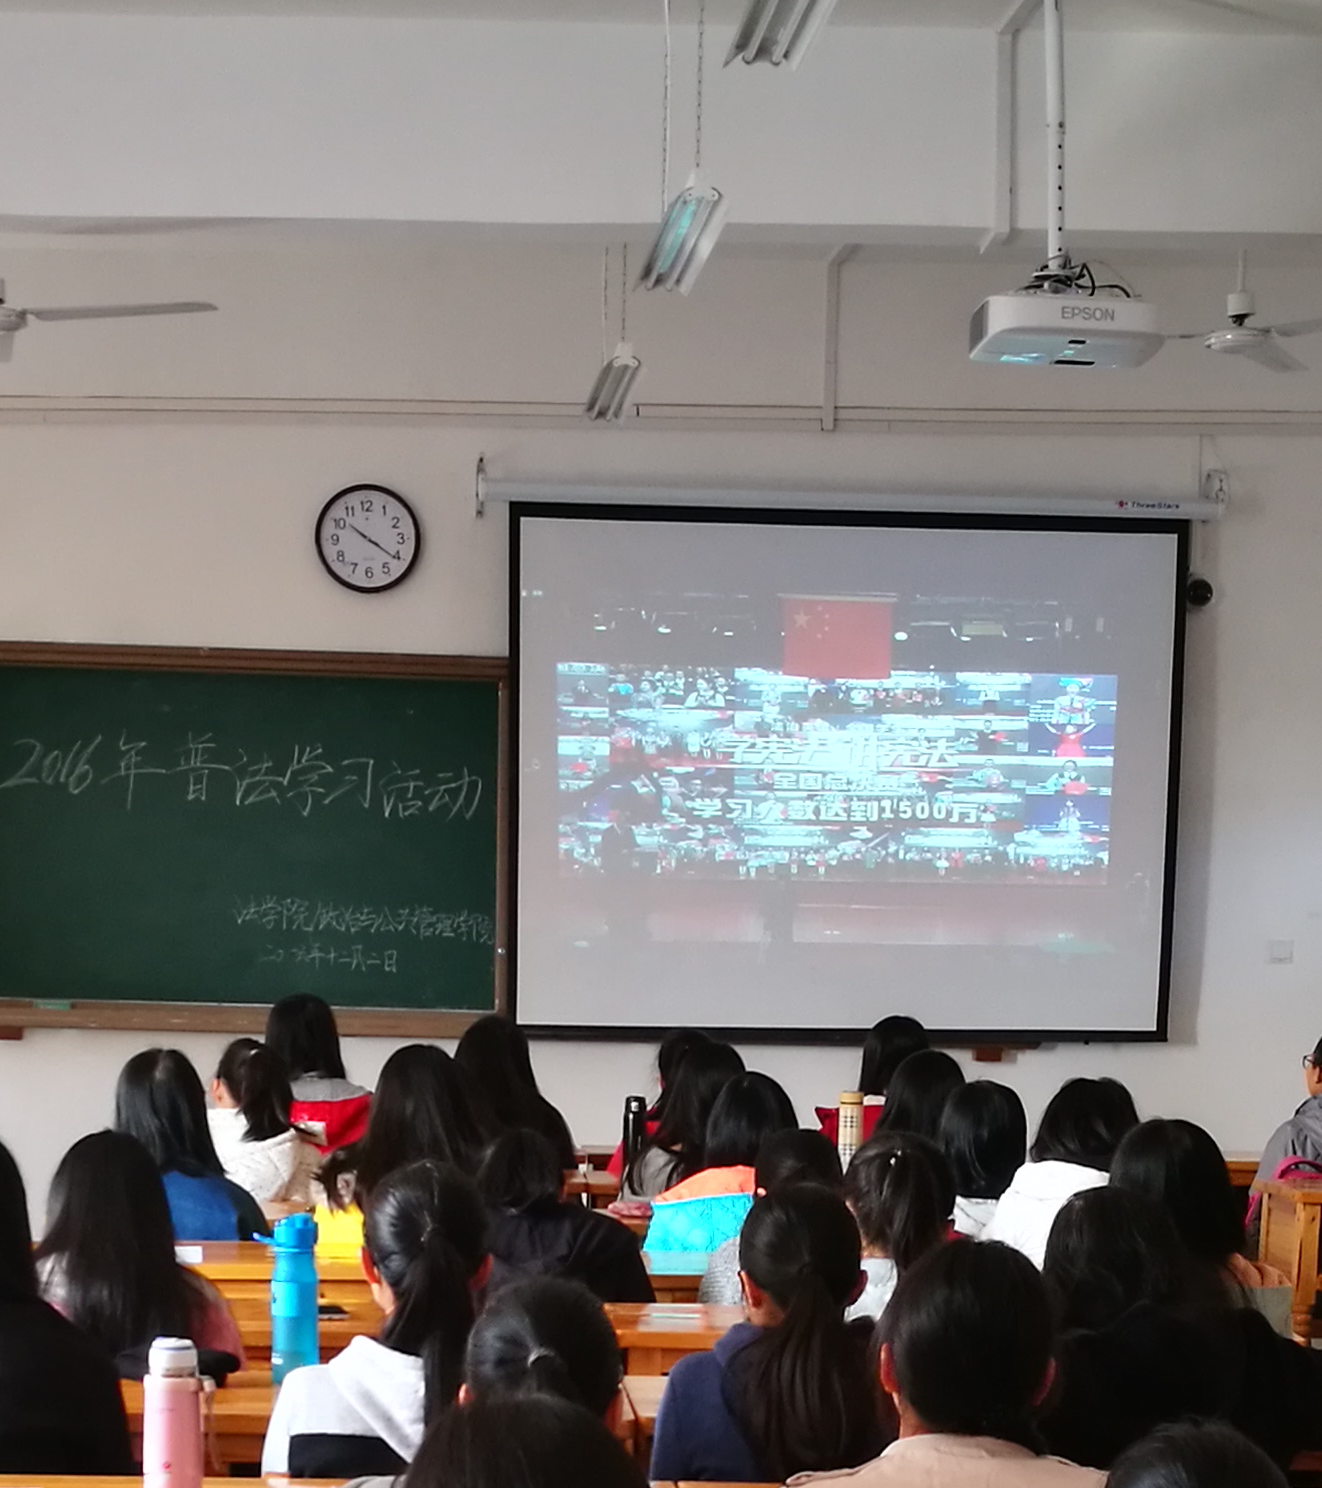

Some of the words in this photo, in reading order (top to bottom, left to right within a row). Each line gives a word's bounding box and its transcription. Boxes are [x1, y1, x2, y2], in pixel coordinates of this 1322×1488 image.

[1061, 306, 1115, 321] EPSON
[344, 505, 355, 517] 11
[360, 500, 373, 512] 12
[382, 504, 387, 516] 1
[333, 517, 346, 530] 10
[391, 516, 400, 529] 2
[330, 533, 339, 546] 9
[396, 532, 405, 545] 3
[336, 550, 345, 562] 8
[393, 550, 401, 561] 4
[350, 562, 358, 574] 7
[364, 566, 374, 579] 6
[382, 562, 391, 574] 5
